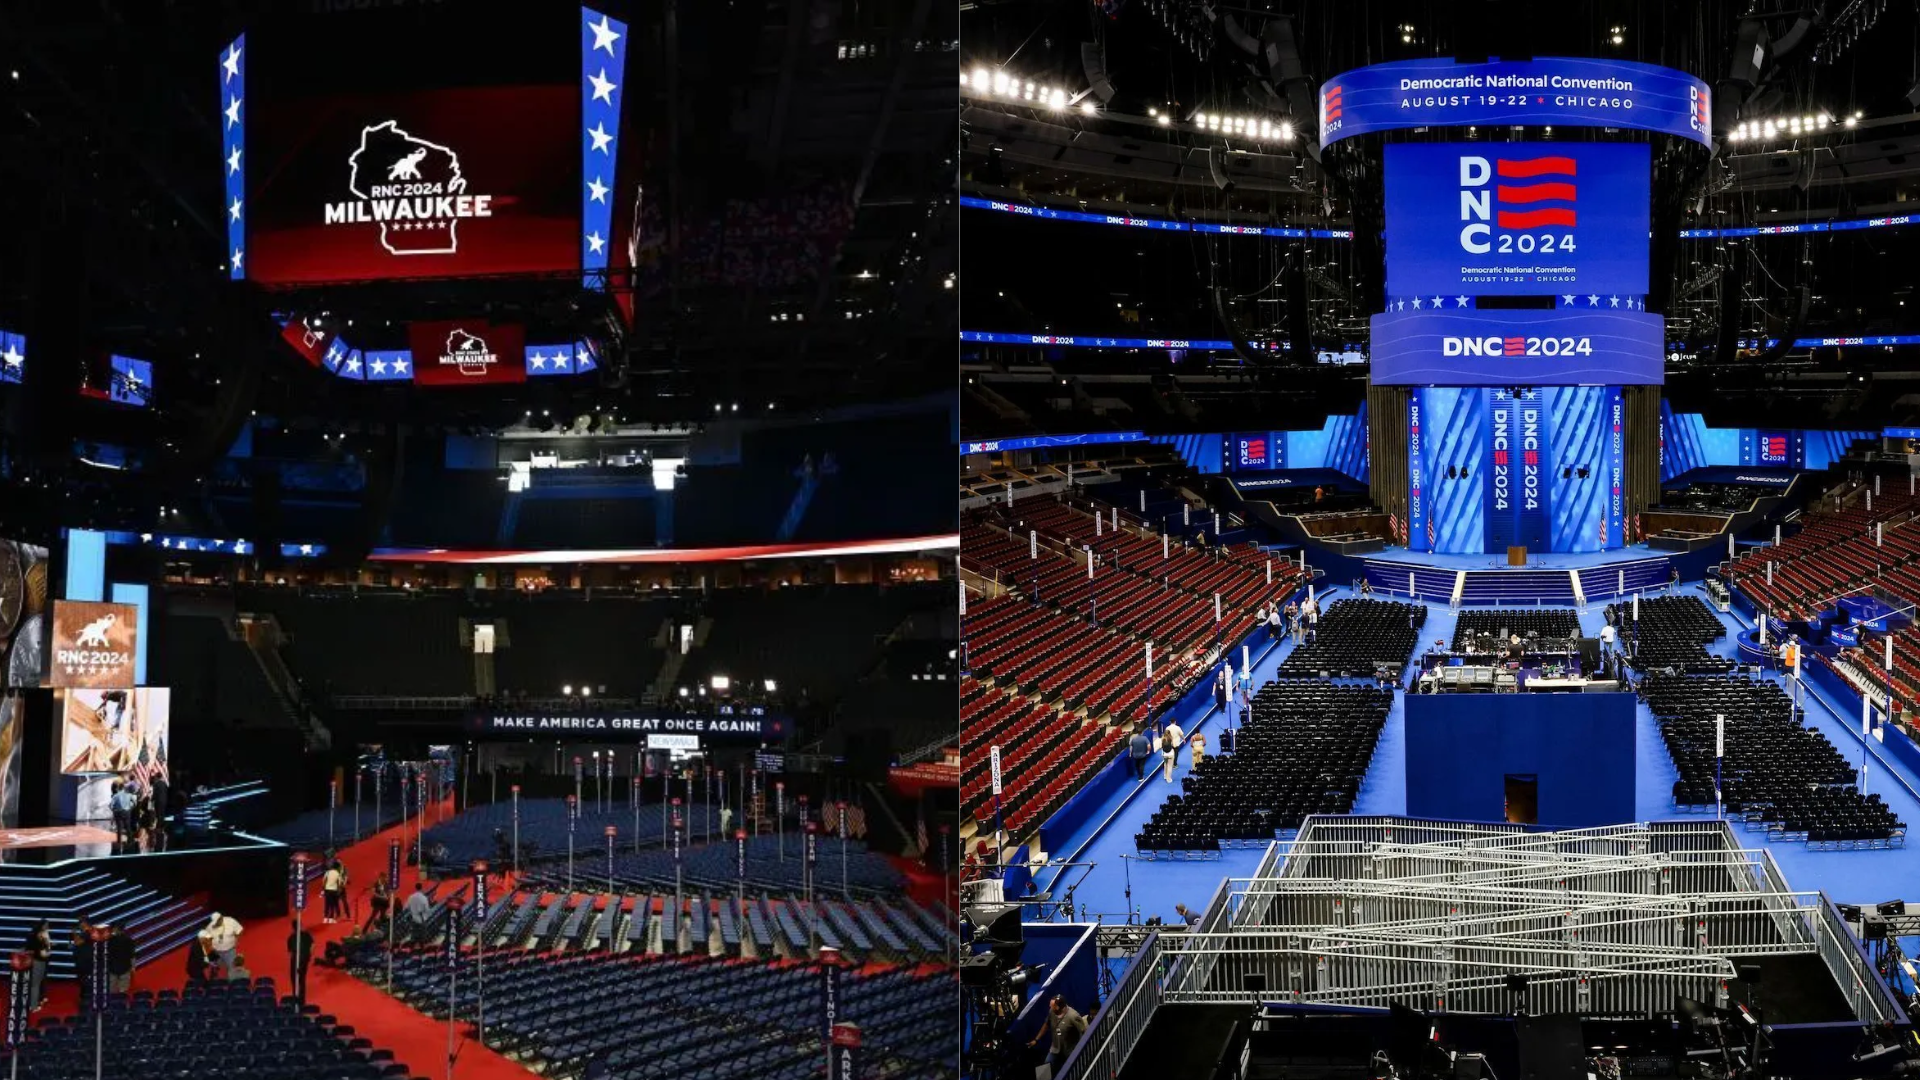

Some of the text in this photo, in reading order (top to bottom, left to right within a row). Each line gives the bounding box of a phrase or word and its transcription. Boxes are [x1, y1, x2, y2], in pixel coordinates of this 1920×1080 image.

[1401, 75, 1633, 91] Democratic National Convention
[1401, 96, 1633, 109] AUGUST 19-22 CHICAGO
[371, 183, 442, 197] RNC 2024
[325, 195, 492, 225] MILWAUKEE
[992, 202, 1032, 214] DNC 2024
[1460, 156, 1491, 254] DNC
[1107, 216, 1148, 227] DNC 2024
[1870, 216, 1909, 227] DNC 2024
[1498, 235, 1576, 253] 2024
[1032, 336, 1074, 345] DNC 2024
[1444, 338, 1592, 356] DNC 2024
[1823, 338, 1839, 346] DNC
[439, 354, 498, 364] MILWAUKEE
[970, 442, 998, 452] DNC 2024
[1494, 410, 1508, 510] DNC 2024
[1524, 410, 1538, 510] DNC 2024
[1412, 469, 1420, 490] DNC
[57, 650, 129, 665] RNC 2024
[494, 718, 762, 732] MAKE AMERICA GREAT ONCE AGAIN!
[649, 736, 696, 746] NEWSMAX
[992, 752, 1000, 788] ARIZONA
[476, 874, 484, 918] TEXAS
[448, 910, 458, 968] ALABAMA
[8, 970, 18, 1044] NEVADA
